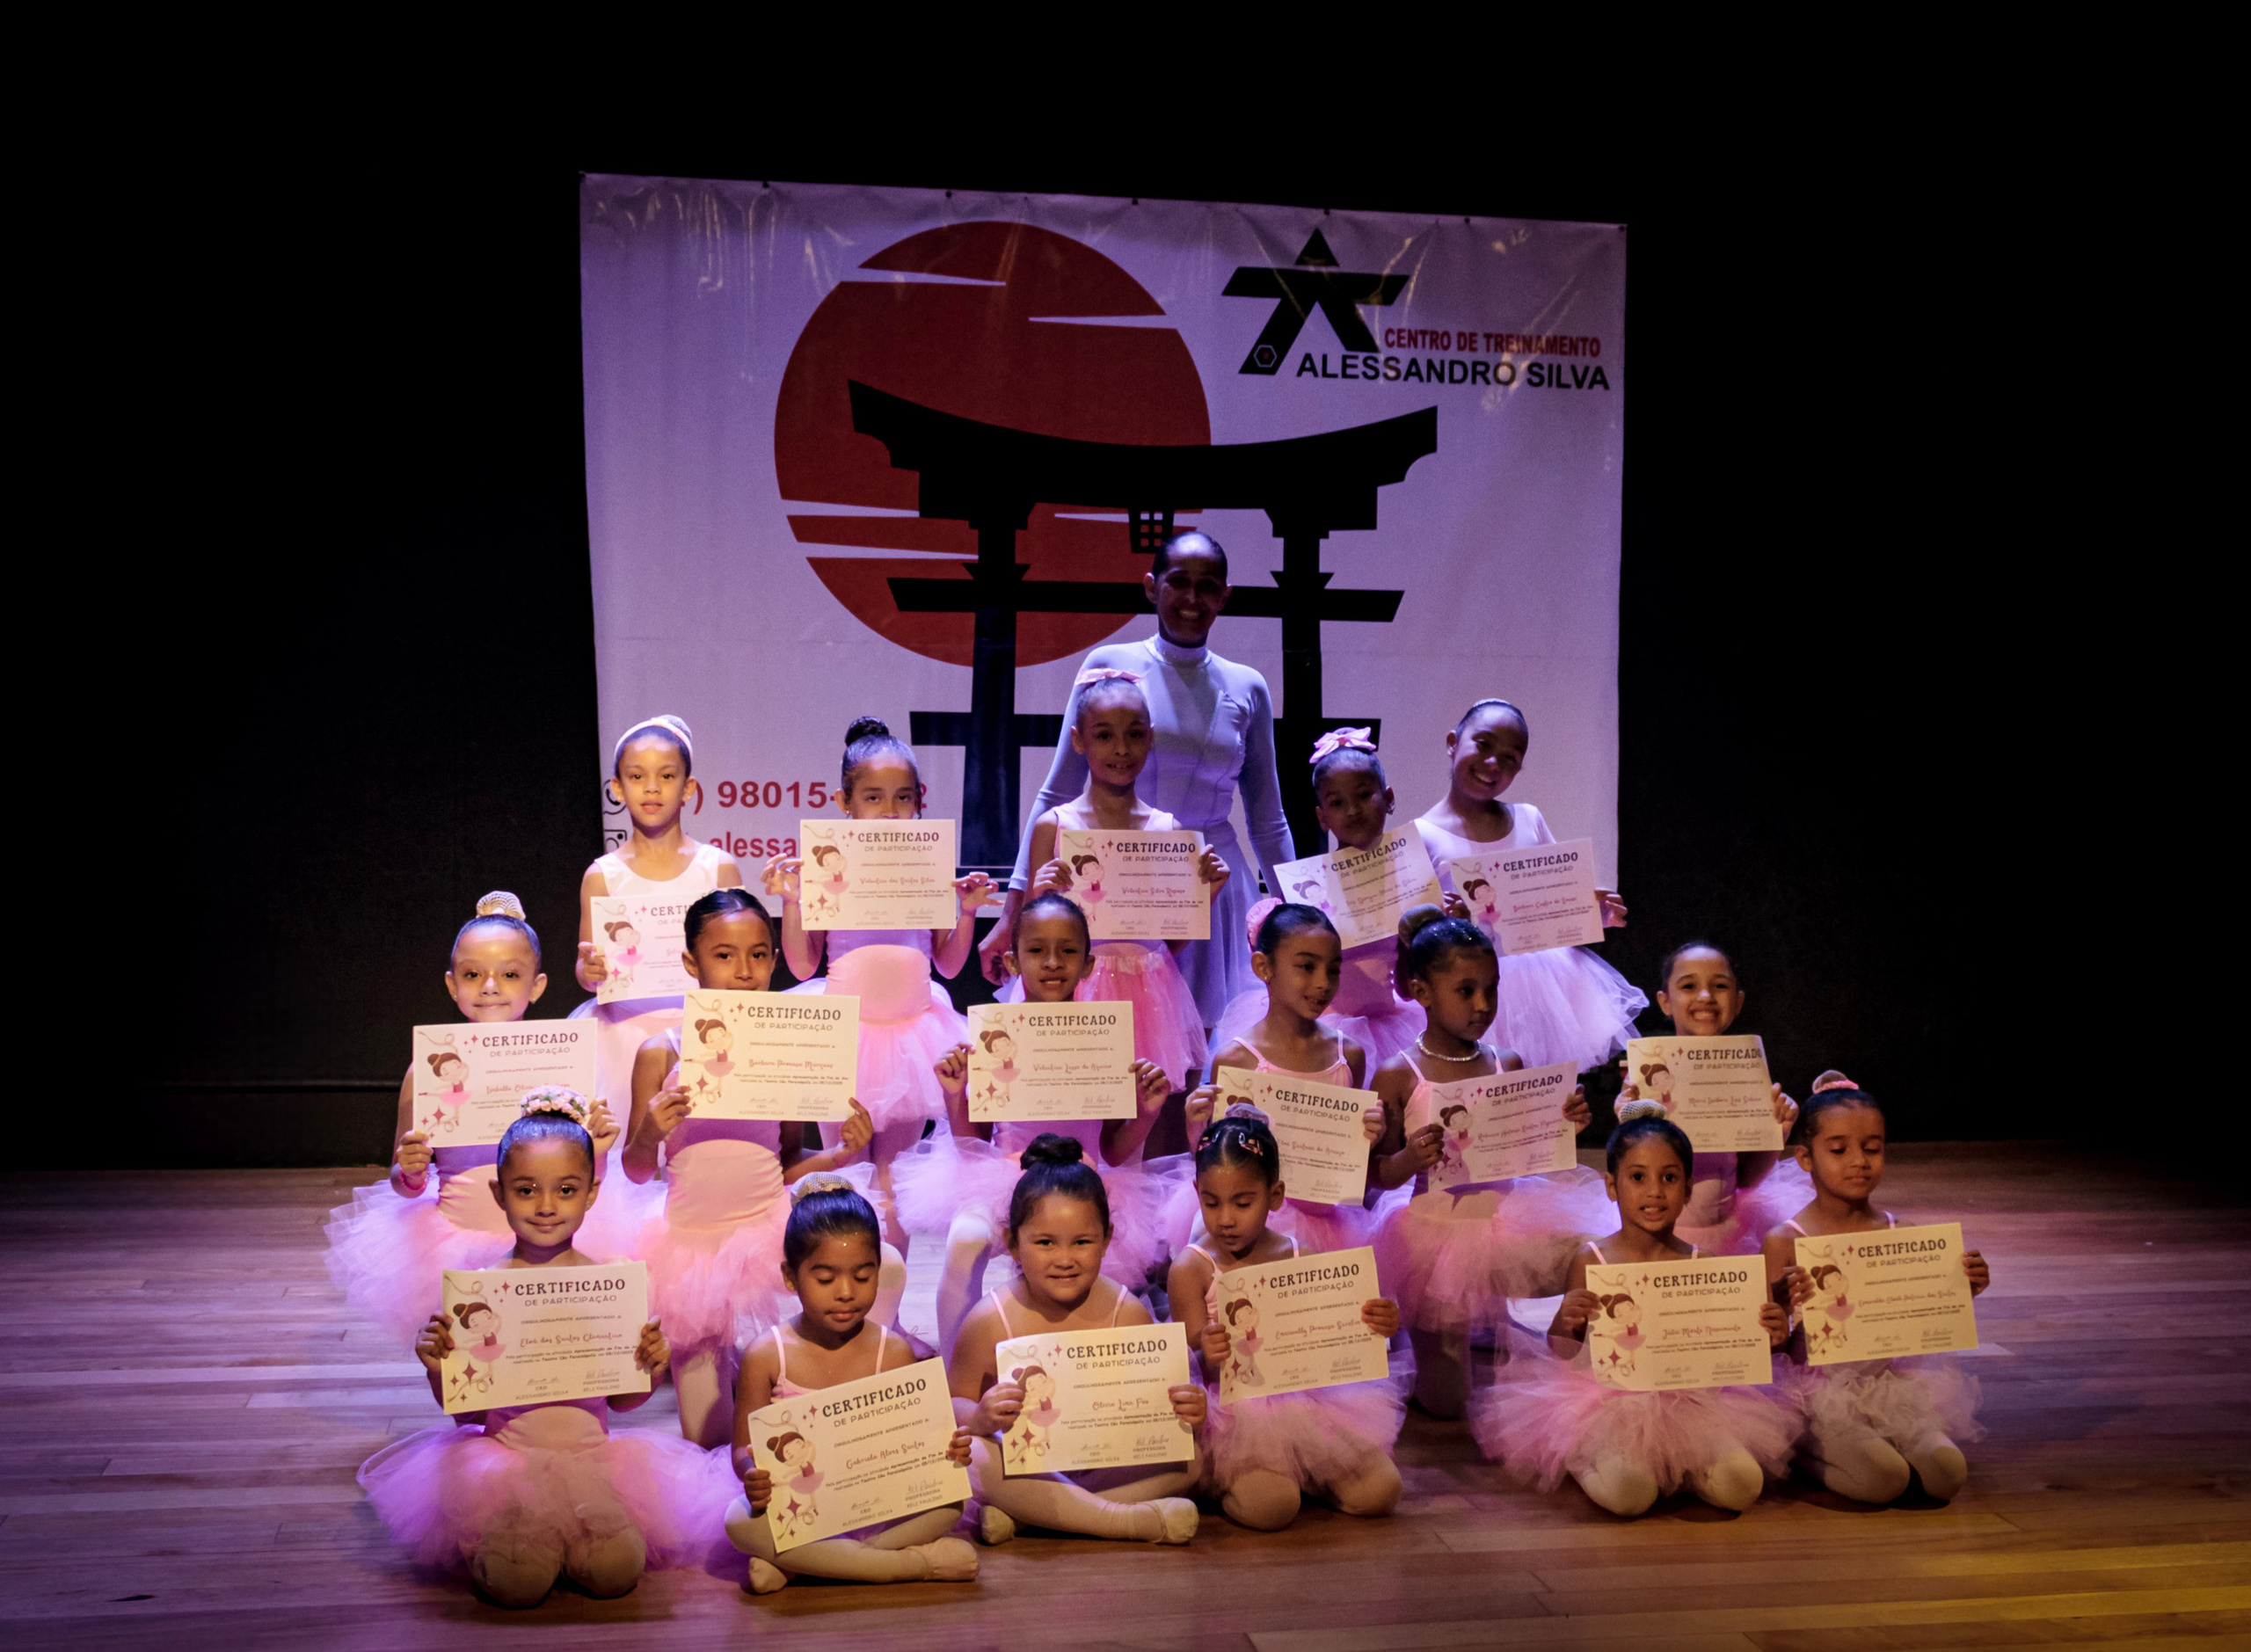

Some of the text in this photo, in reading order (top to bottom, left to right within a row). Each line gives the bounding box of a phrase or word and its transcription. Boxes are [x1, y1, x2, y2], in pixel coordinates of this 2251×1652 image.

[1384, 328, 1600, 357] CENTRO DE TREINAMENTO
[1296, 353, 1610, 390] ALESSANDRO SILVA
[857, 832, 939, 842] CERTIFICADO
[1116, 842, 1196, 853] CERTIFICADO
[1330, 837, 1408, 873] CERTIFICADO
[1503, 851, 1578, 872] CERTIFICADO
[747, 1006, 841, 1021] CERTIFICADO
[1029, 1015, 1116, 1026] CERTIFICADO
[769, 1022, 834, 1032] PARTICIPAÇÃO
[1050, 1028, 1110, 1037] PARTICIPAÇÃO
[482, 1032, 579, 1047] CERTIFICADO
[1485, 1073, 1563, 1098] CERTIFICADO
[1274, 1088, 1359, 1113] CERTIFICADO
[1857, 1238, 1946, 1258] CERTIFICADO
[1269, 1263, 1359, 1289] CERTIFICADO
[1653, 1270, 1747, 1288] CERTIFICADO
[514, 1278, 624, 1296] CERTIFICADO
[1277, 1279, 1354, 1299] DE PARTICIPAÇÃO
[542, 1293, 616, 1306] PARTICIPAÇÃO
[555, 1334, 579, 1343] Santos
[1066, 1339, 1167, 1359] CERTIFICADO
[1091, 1356, 1161, 1370] PARTICIPAÇÃO
[821, 1377, 927, 1418] CERTIFICADO
[833, 1395, 922, 1428] DE PARTICIPAÇÃO
[845, 1452, 878, 1470] Gabriela
[900, 1438, 925, 1453] Santos
